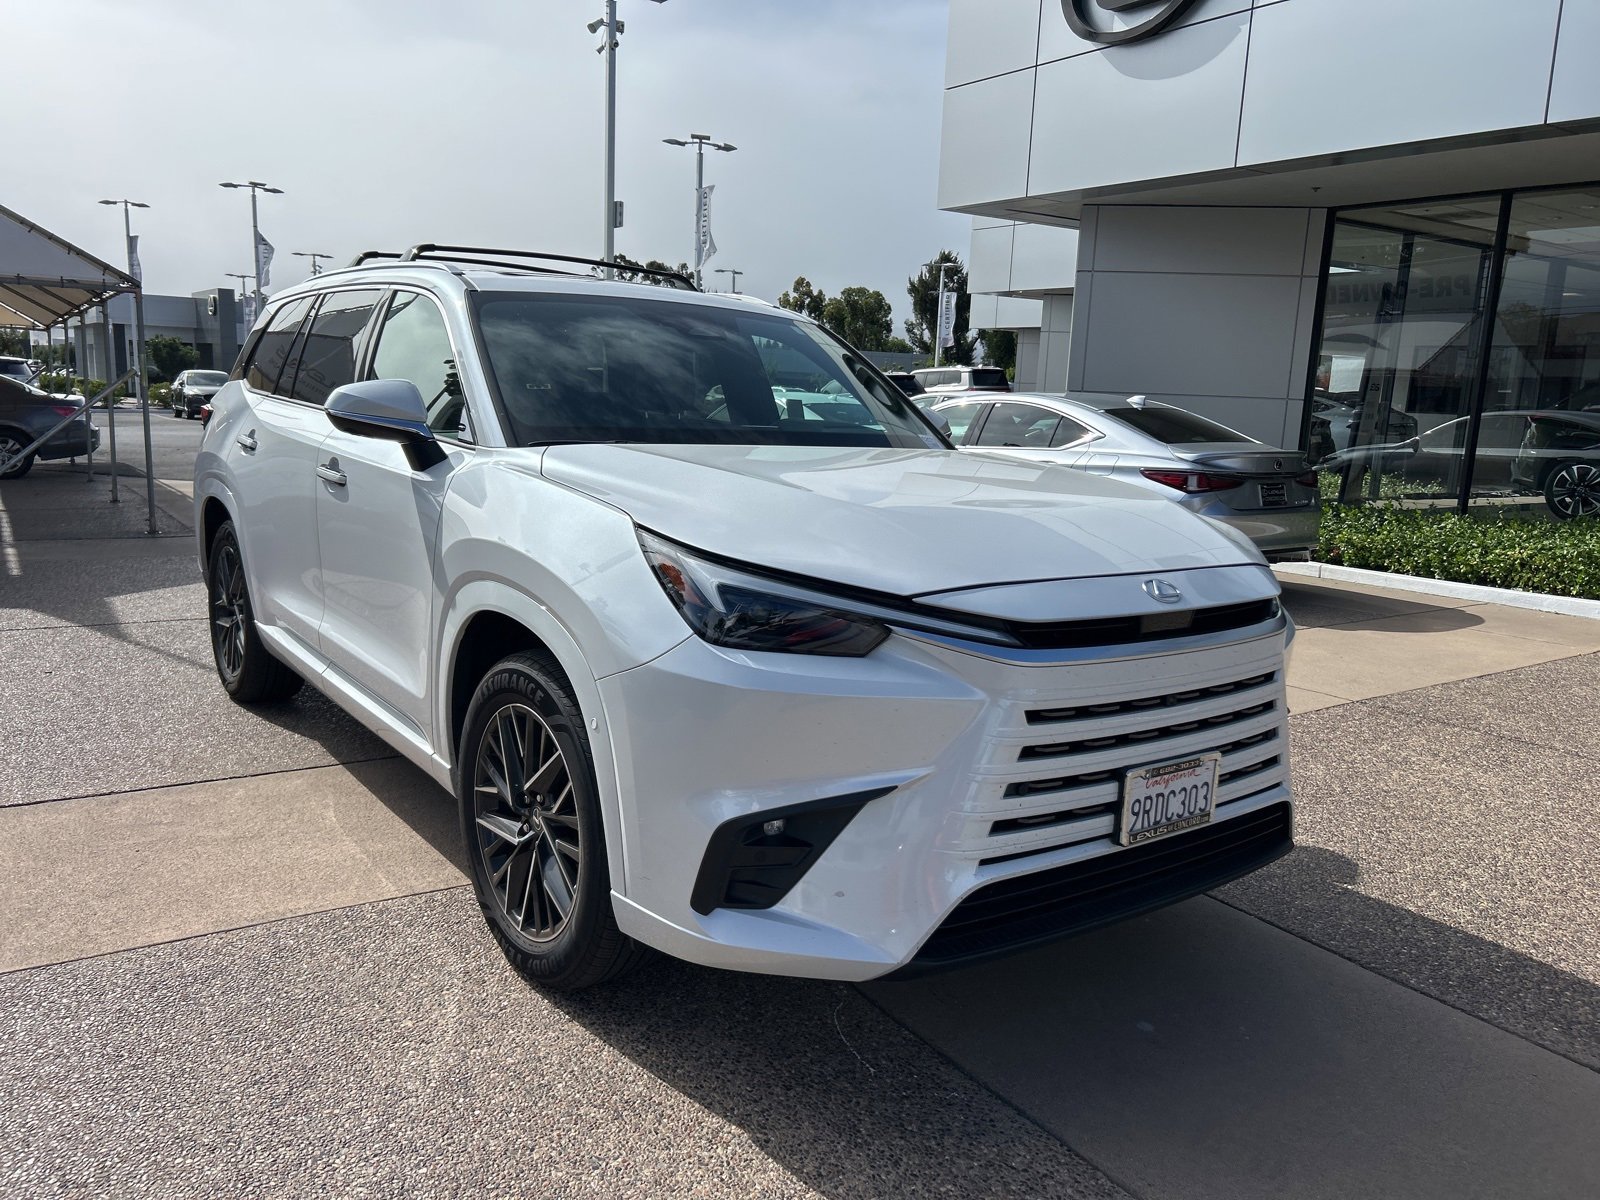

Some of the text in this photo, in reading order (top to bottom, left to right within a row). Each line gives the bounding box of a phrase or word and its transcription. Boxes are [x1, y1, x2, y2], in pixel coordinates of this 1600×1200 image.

[477, 672, 545, 706] ASSURANCE
[1145, 768, 1201, 789] California
[1129, 781, 1210, 833] 9RDC303
[1130, 825, 1167, 843] LEXUS
